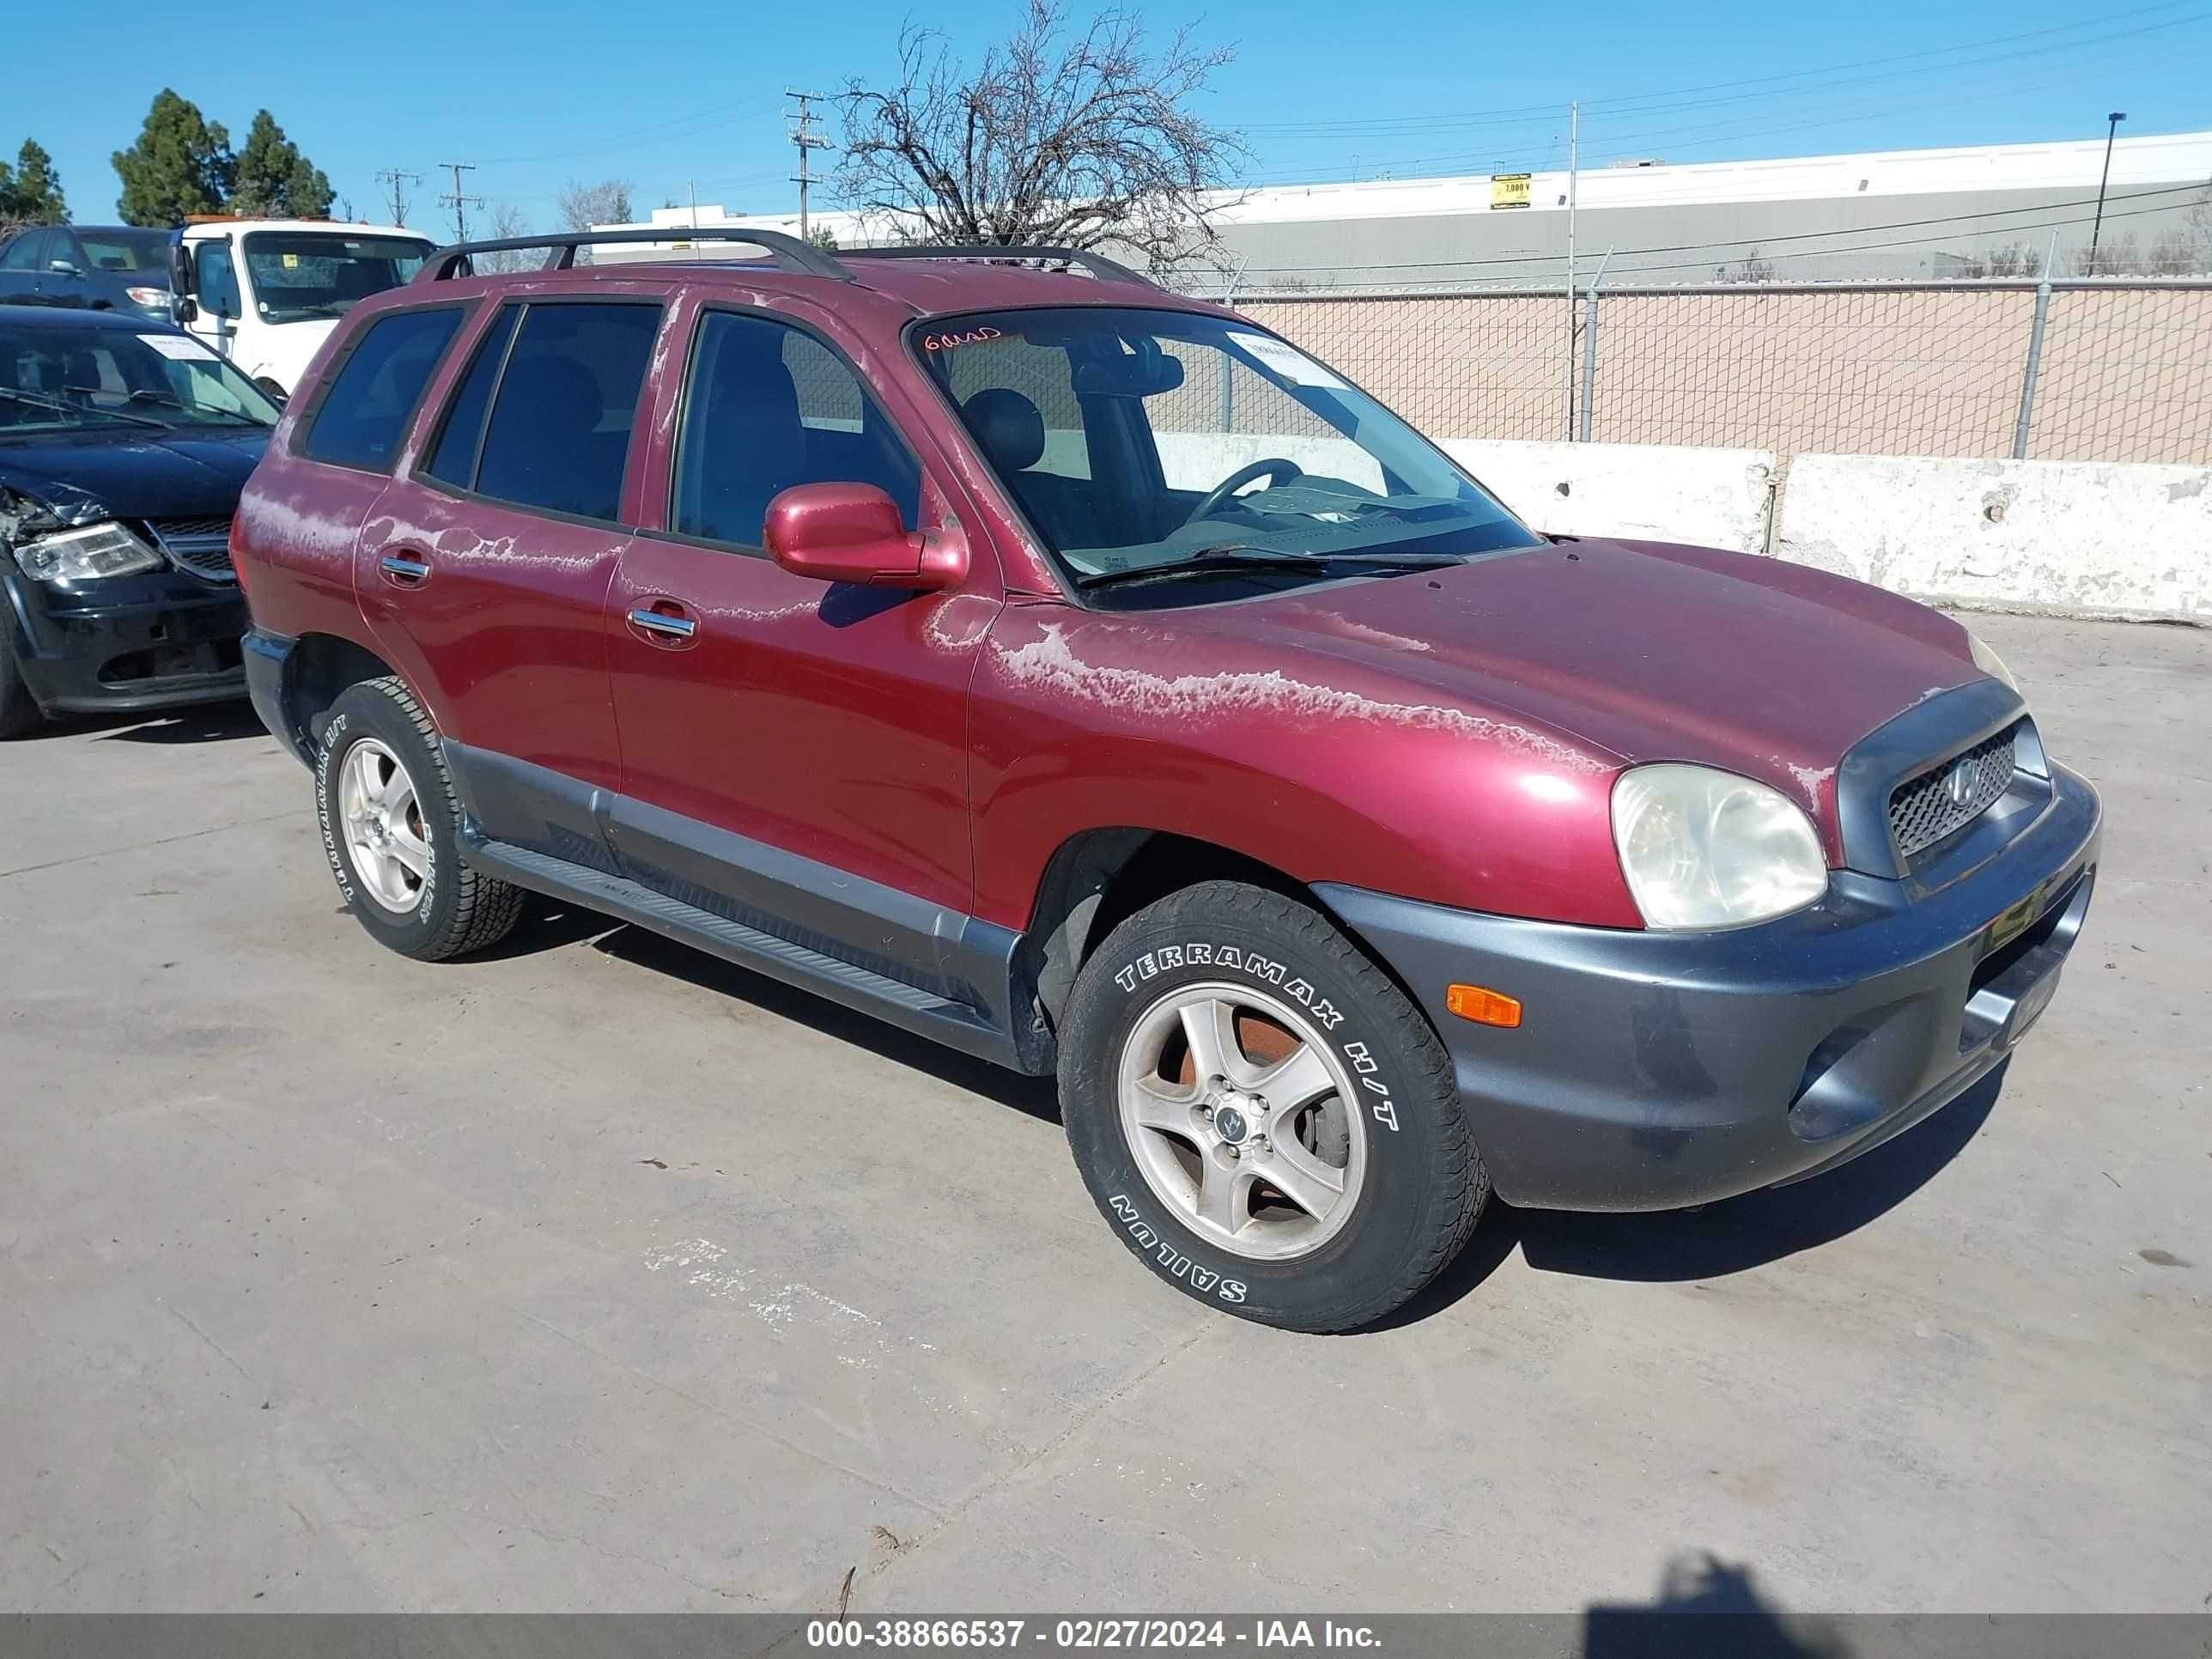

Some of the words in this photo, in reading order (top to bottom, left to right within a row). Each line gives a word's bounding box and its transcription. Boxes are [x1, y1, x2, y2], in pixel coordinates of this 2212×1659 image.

[1505, 183, 1524, 193] 7,000
[1115, 943, 1345, 1030] TERRAMAX
[1343, 1041, 1400, 1133] H/T
[1108, 1194, 1248, 1303] SAILUN
